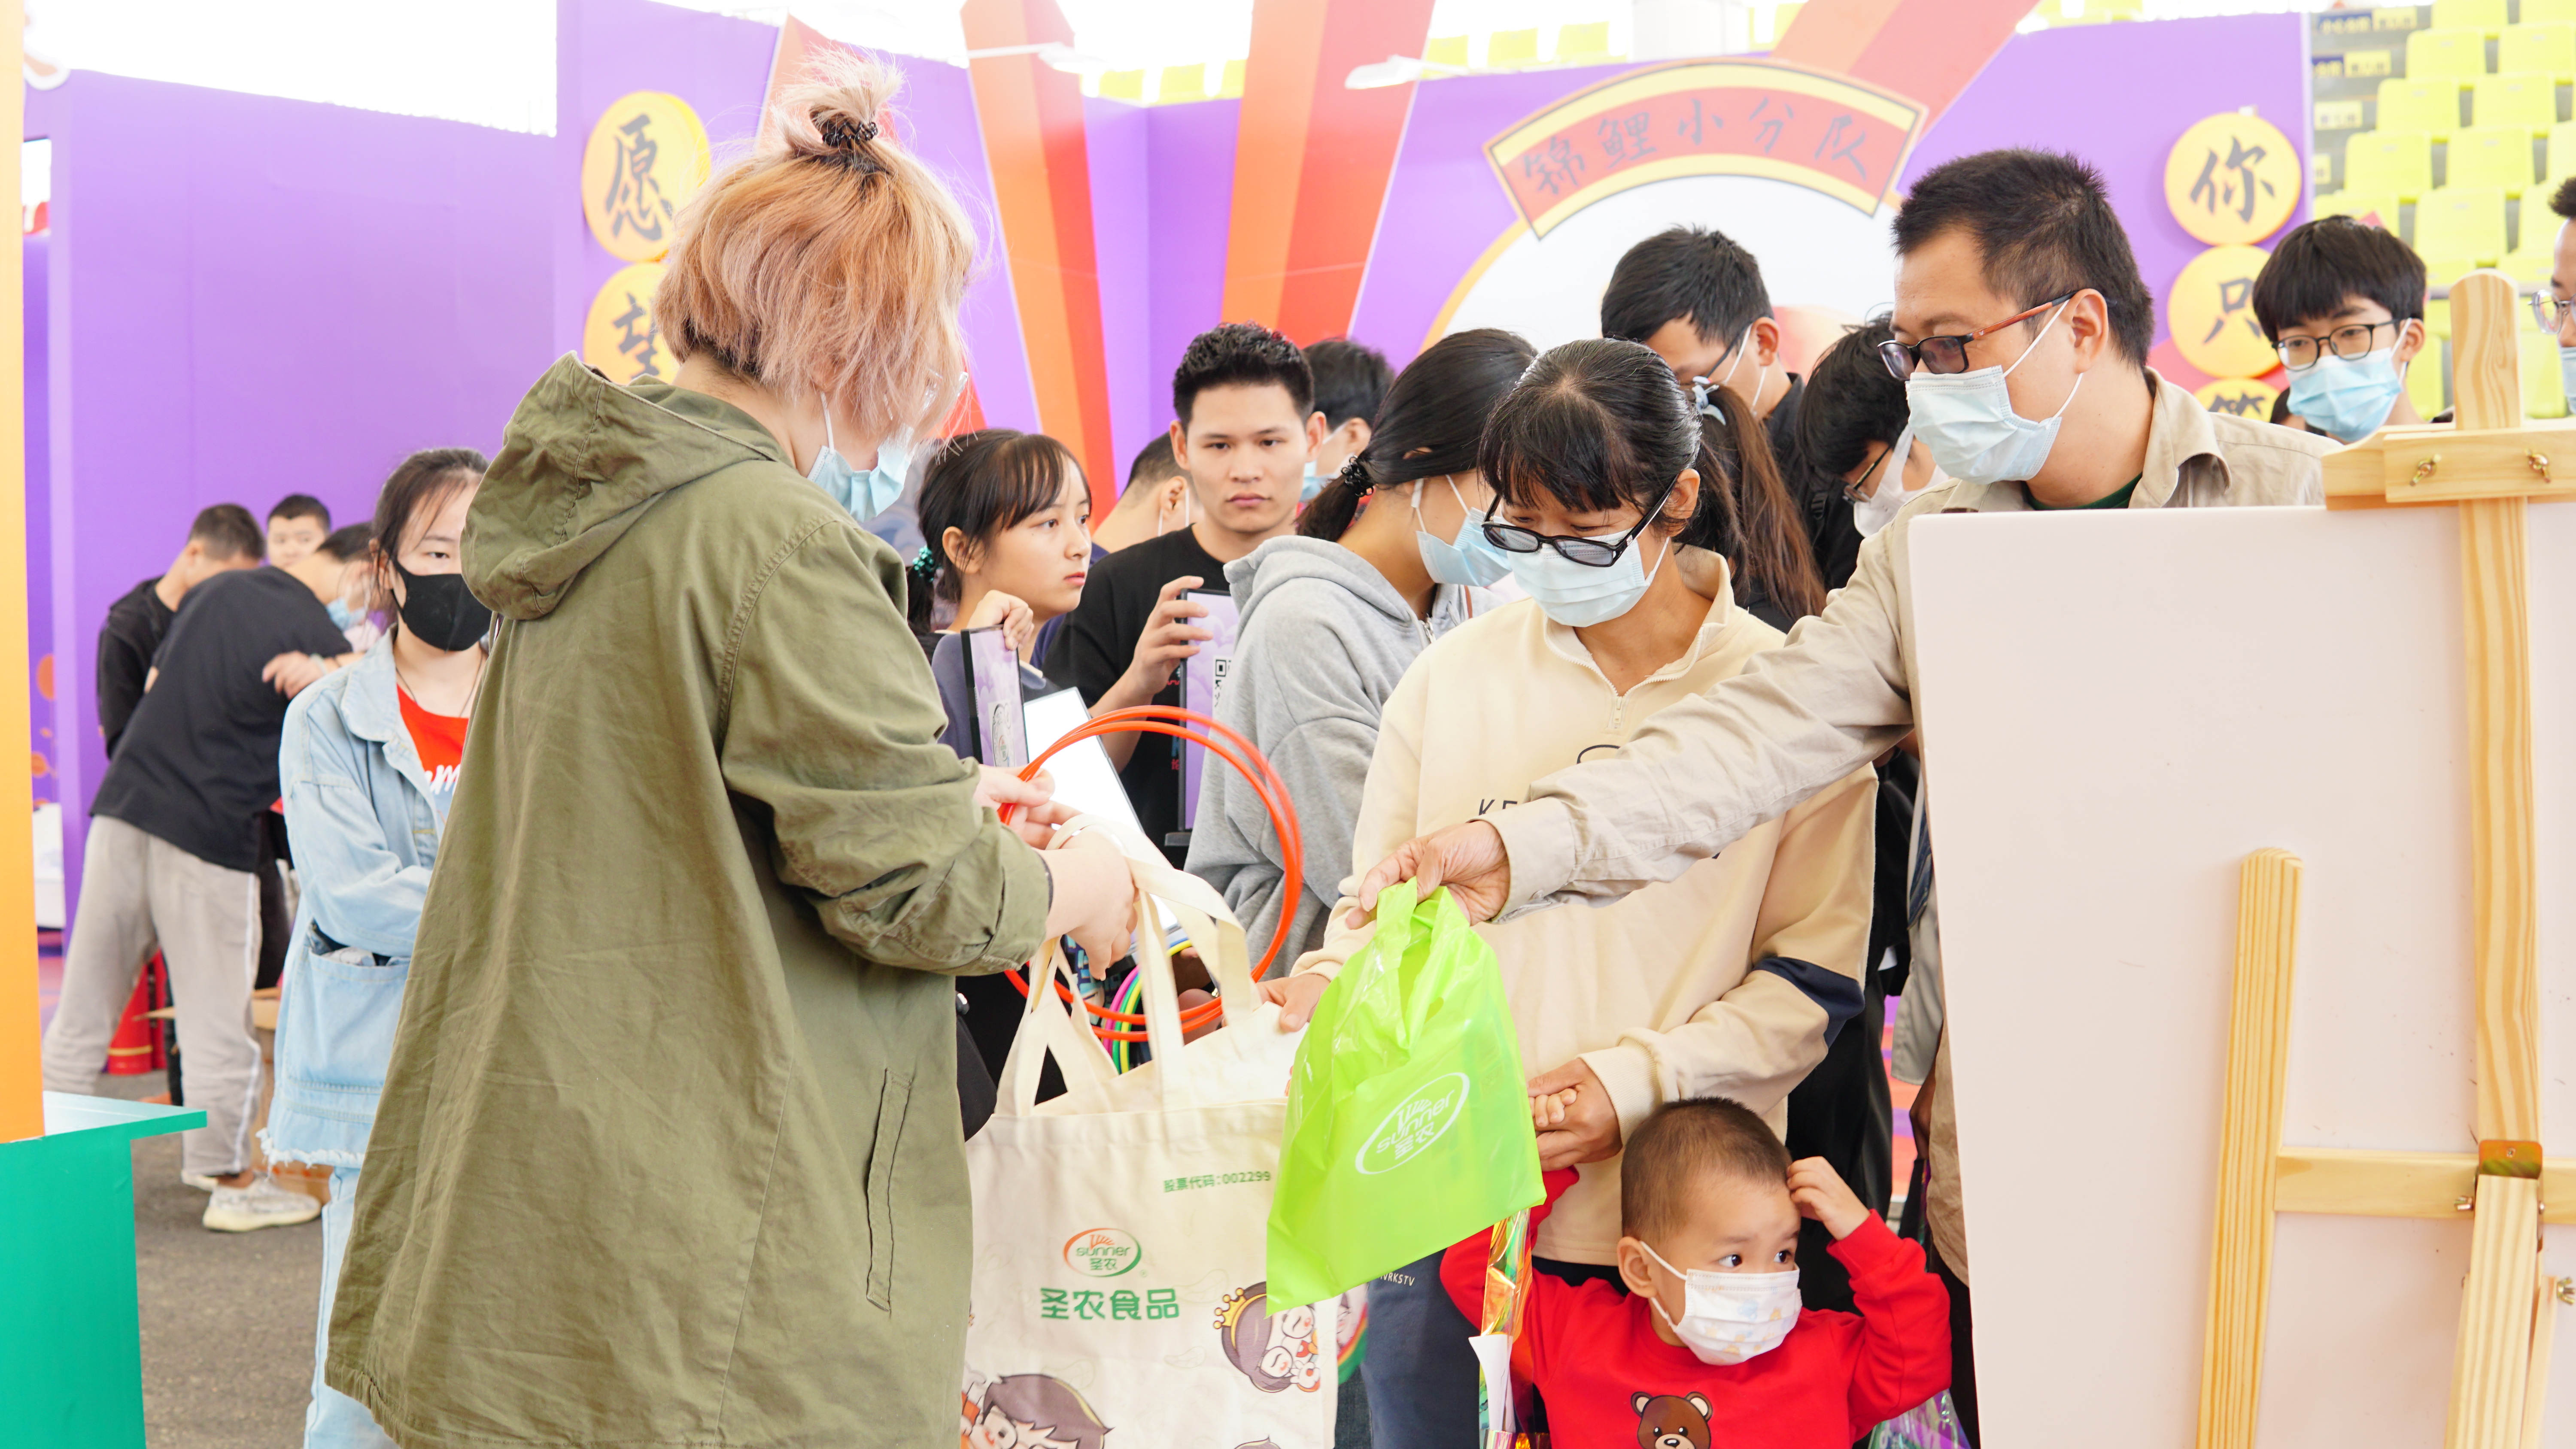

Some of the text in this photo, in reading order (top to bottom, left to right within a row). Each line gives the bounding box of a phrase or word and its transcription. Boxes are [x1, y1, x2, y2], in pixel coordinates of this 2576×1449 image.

[1523, 96, 1869, 196] 锦鲤小分队
[1376, 1088, 1455, 1154] sunner
[1394, 1121, 1435, 1161] 圣农
[1076, 1246, 1131, 1257] sunner
[1089, 1257, 1117, 1270] 圣农
[1040, 1287, 1180, 1320] 圣农食品
